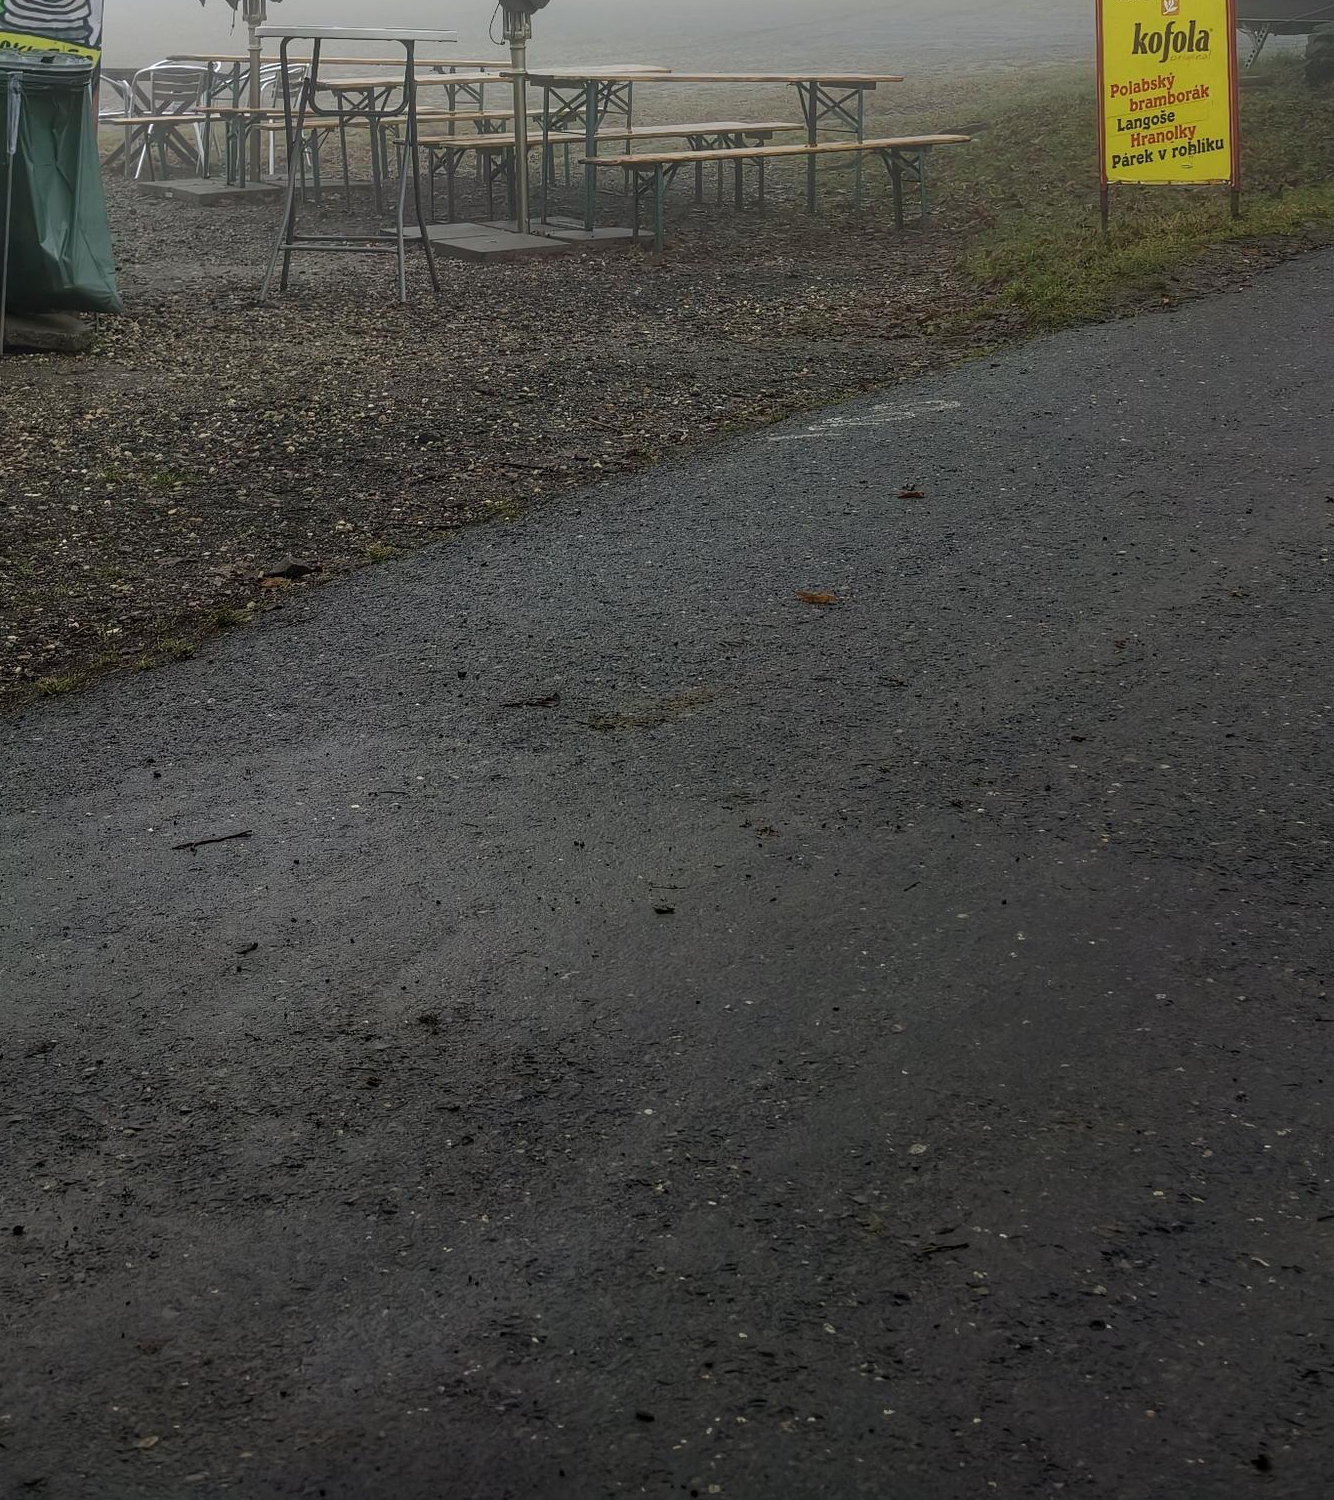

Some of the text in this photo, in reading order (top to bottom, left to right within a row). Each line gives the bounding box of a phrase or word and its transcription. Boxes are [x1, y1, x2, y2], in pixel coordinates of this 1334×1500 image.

[1132, 20, 1210, 63] kofola
[1110, 72, 1175, 98] Polabský
[1129, 85, 1209, 112] bramborák
[1117, 110, 1175, 132] Langoše
[1131, 124, 1196, 148] Hranolky
[1112, 149, 1154, 169] Párek
[1158, 149, 1167, 160] v
